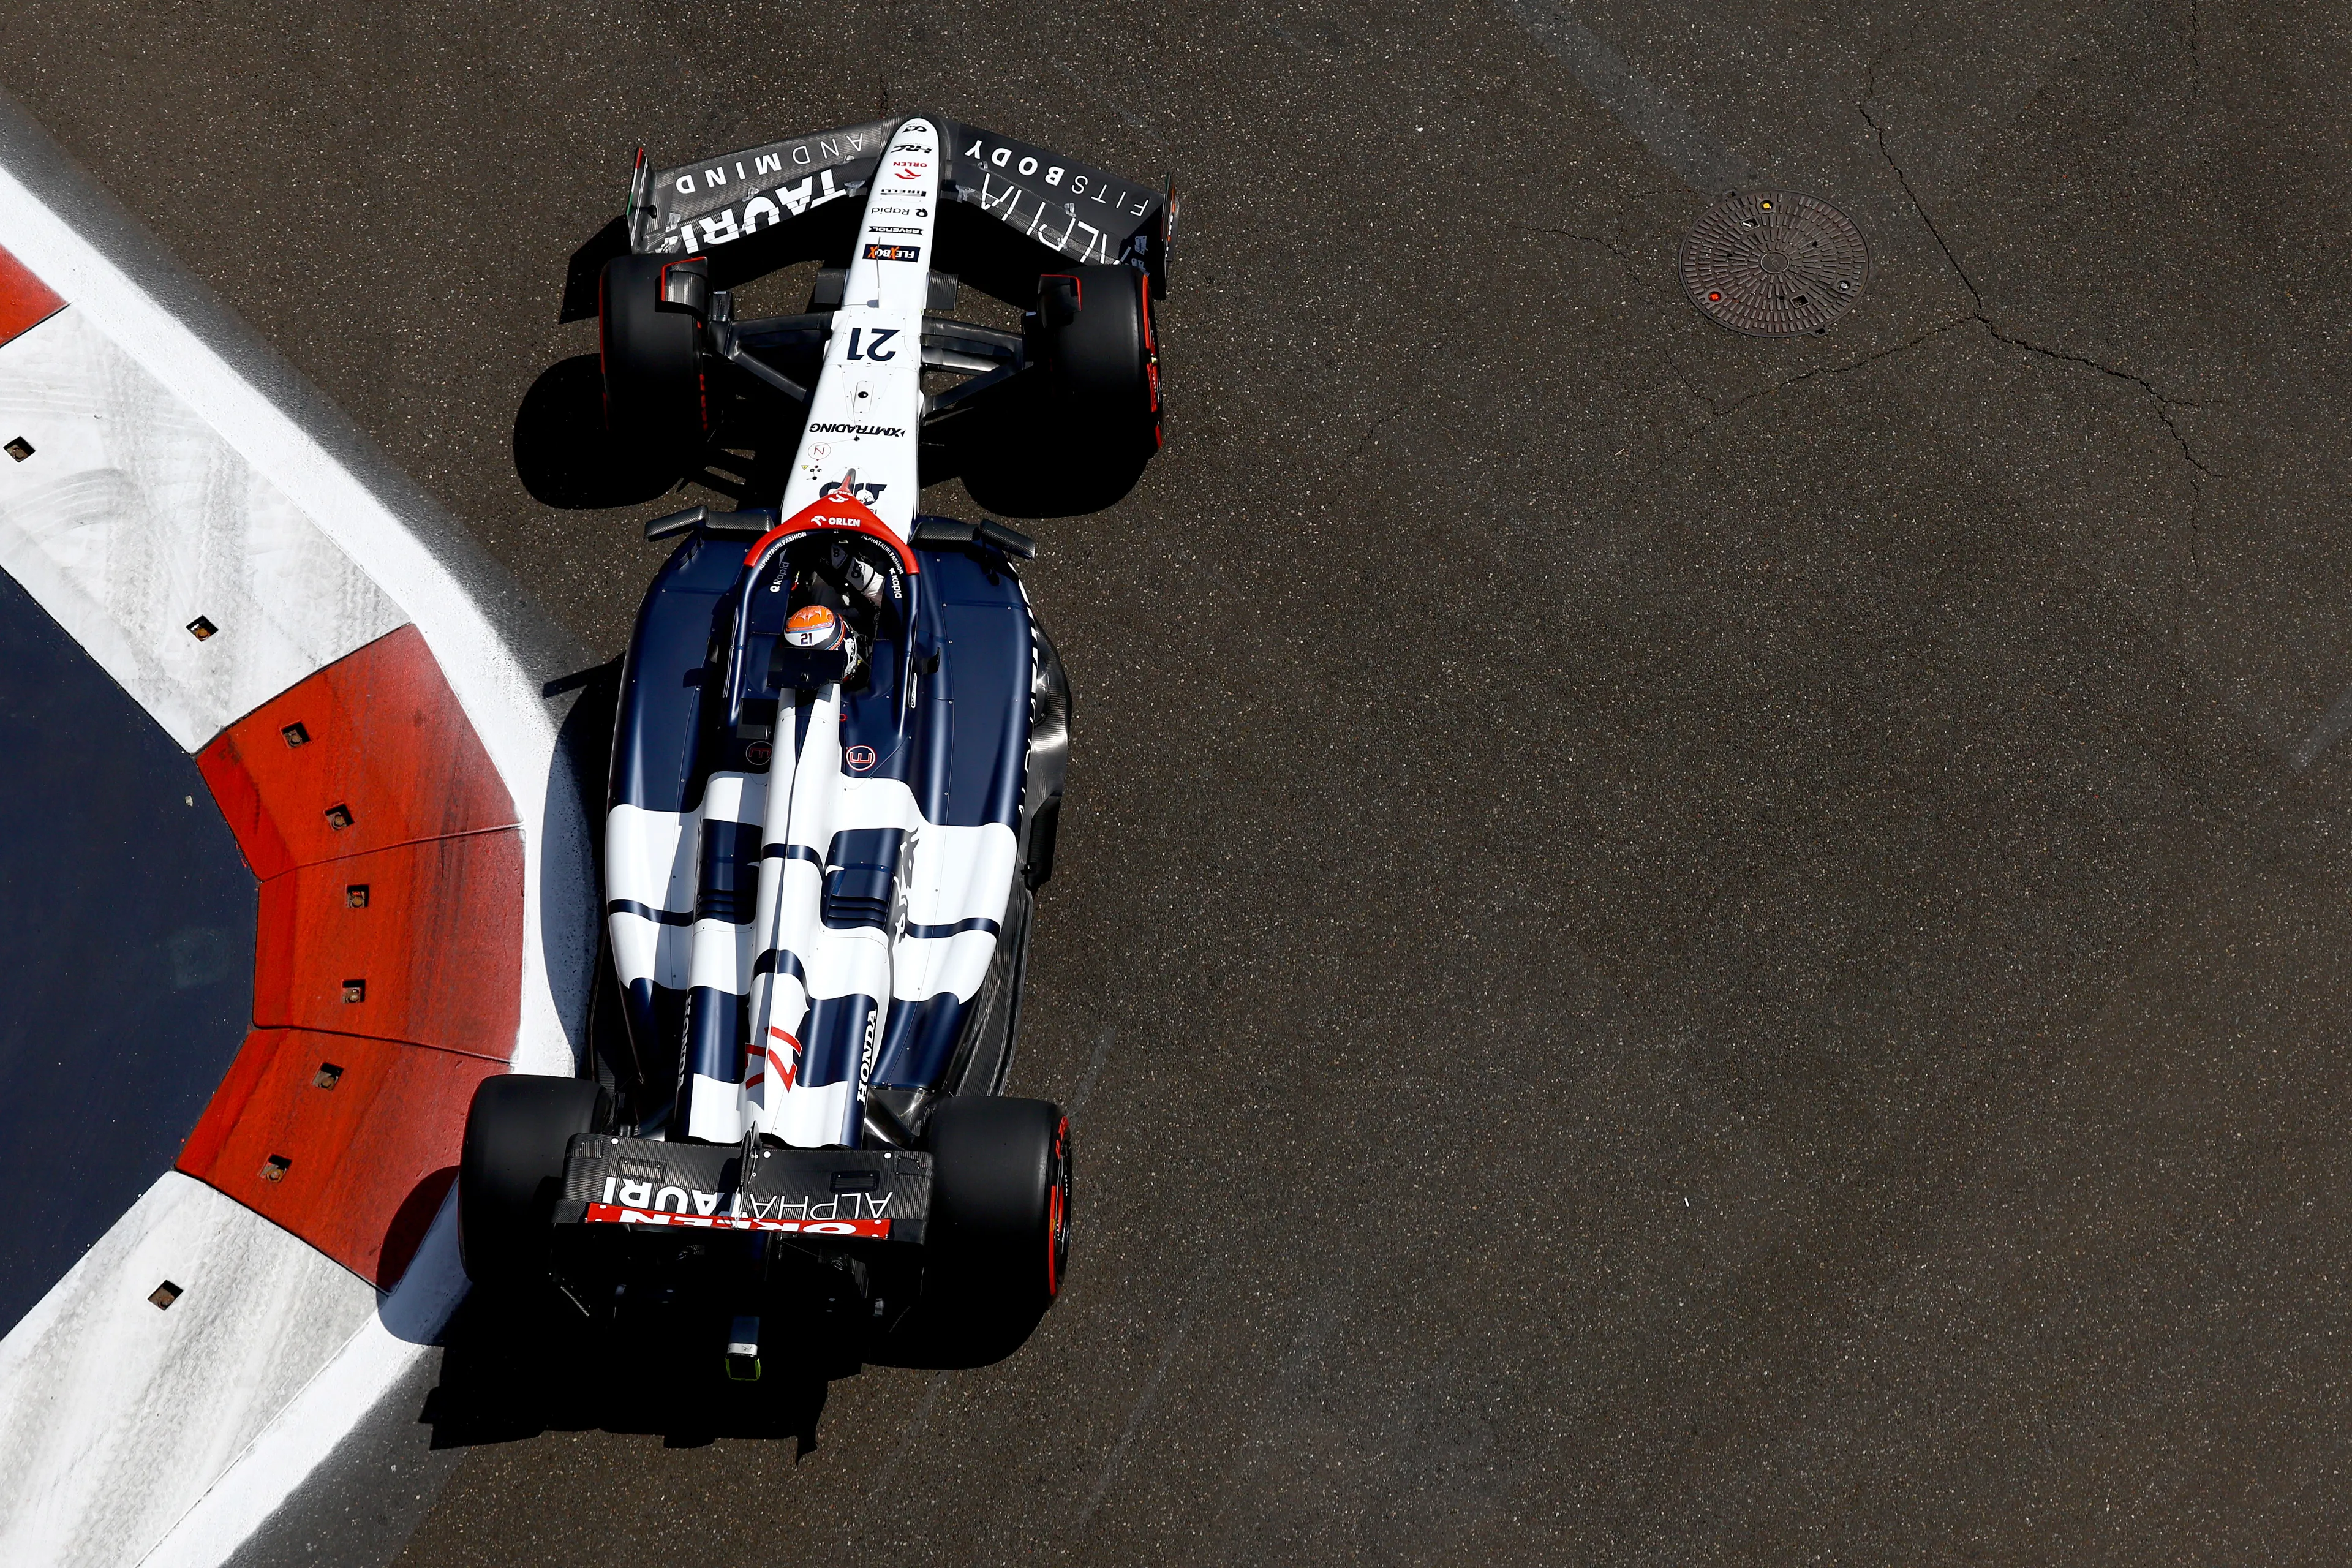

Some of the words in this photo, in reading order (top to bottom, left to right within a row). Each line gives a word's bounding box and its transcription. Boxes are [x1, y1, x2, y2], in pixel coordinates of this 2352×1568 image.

[680, 169, 847, 254] TAURI
[871, 207, 910, 216] Rapid
[867, 246, 915, 260] FLEXBOX
[846, 327, 901, 362] 21
[828, 517, 861, 527] ORLEN
[801, 633, 813, 645] 21
[677, 995, 692, 1091] HONDA
[857, 1009, 878, 1106] HONDA
[602, 1176, 893, 1221] ALPHATAURI
